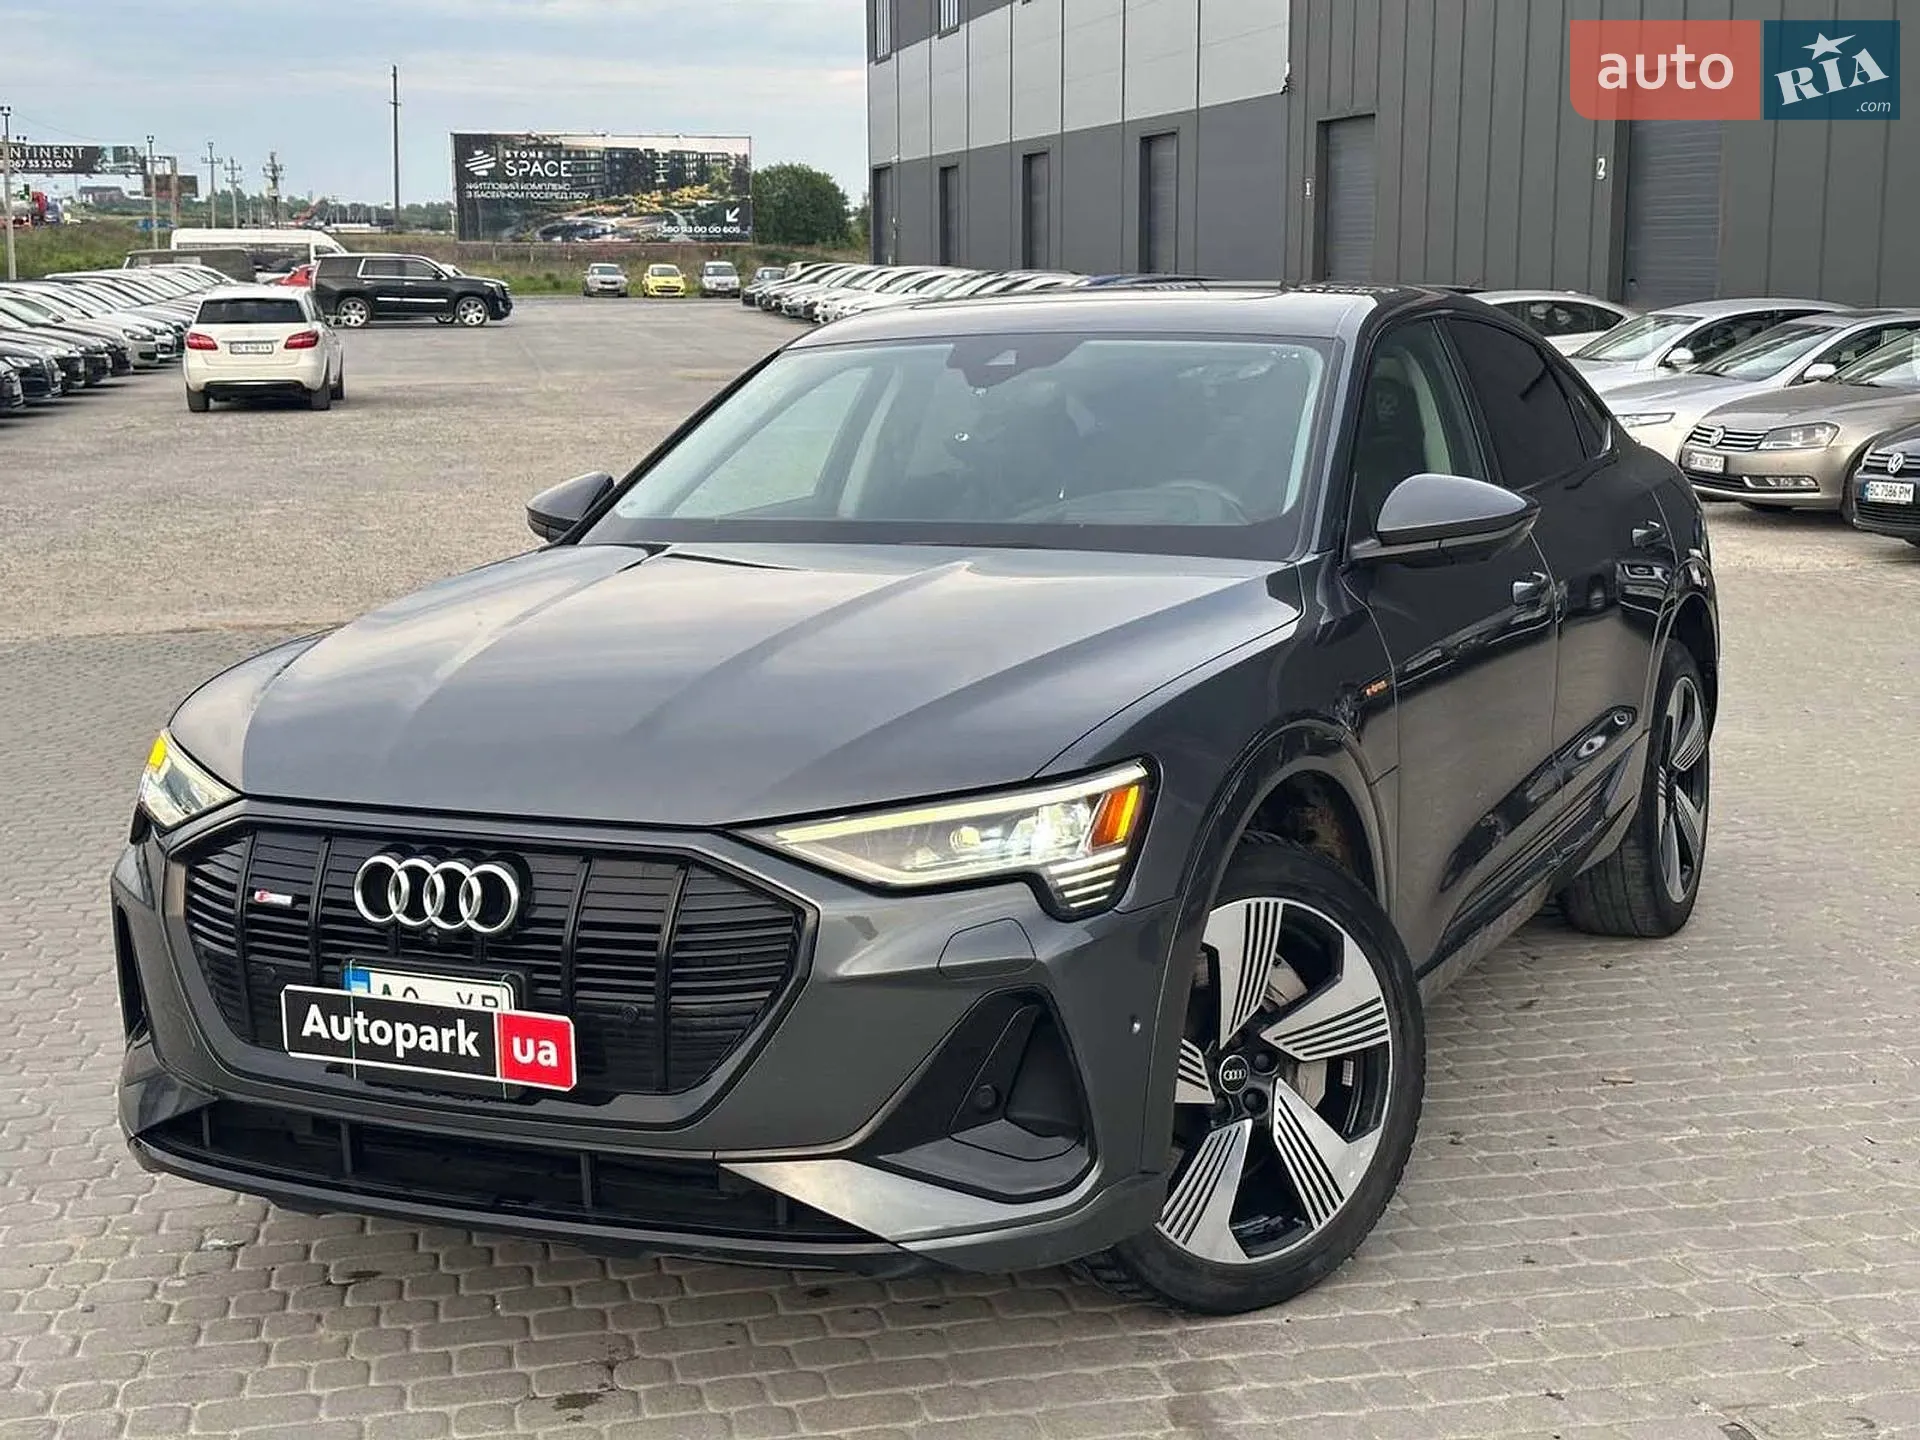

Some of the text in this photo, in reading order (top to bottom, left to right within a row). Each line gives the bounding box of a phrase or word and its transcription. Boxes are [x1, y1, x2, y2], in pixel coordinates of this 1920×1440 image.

[505, 161, 572, 177] SPACE
[301, 1004, 558, 1068] Autopark ua
